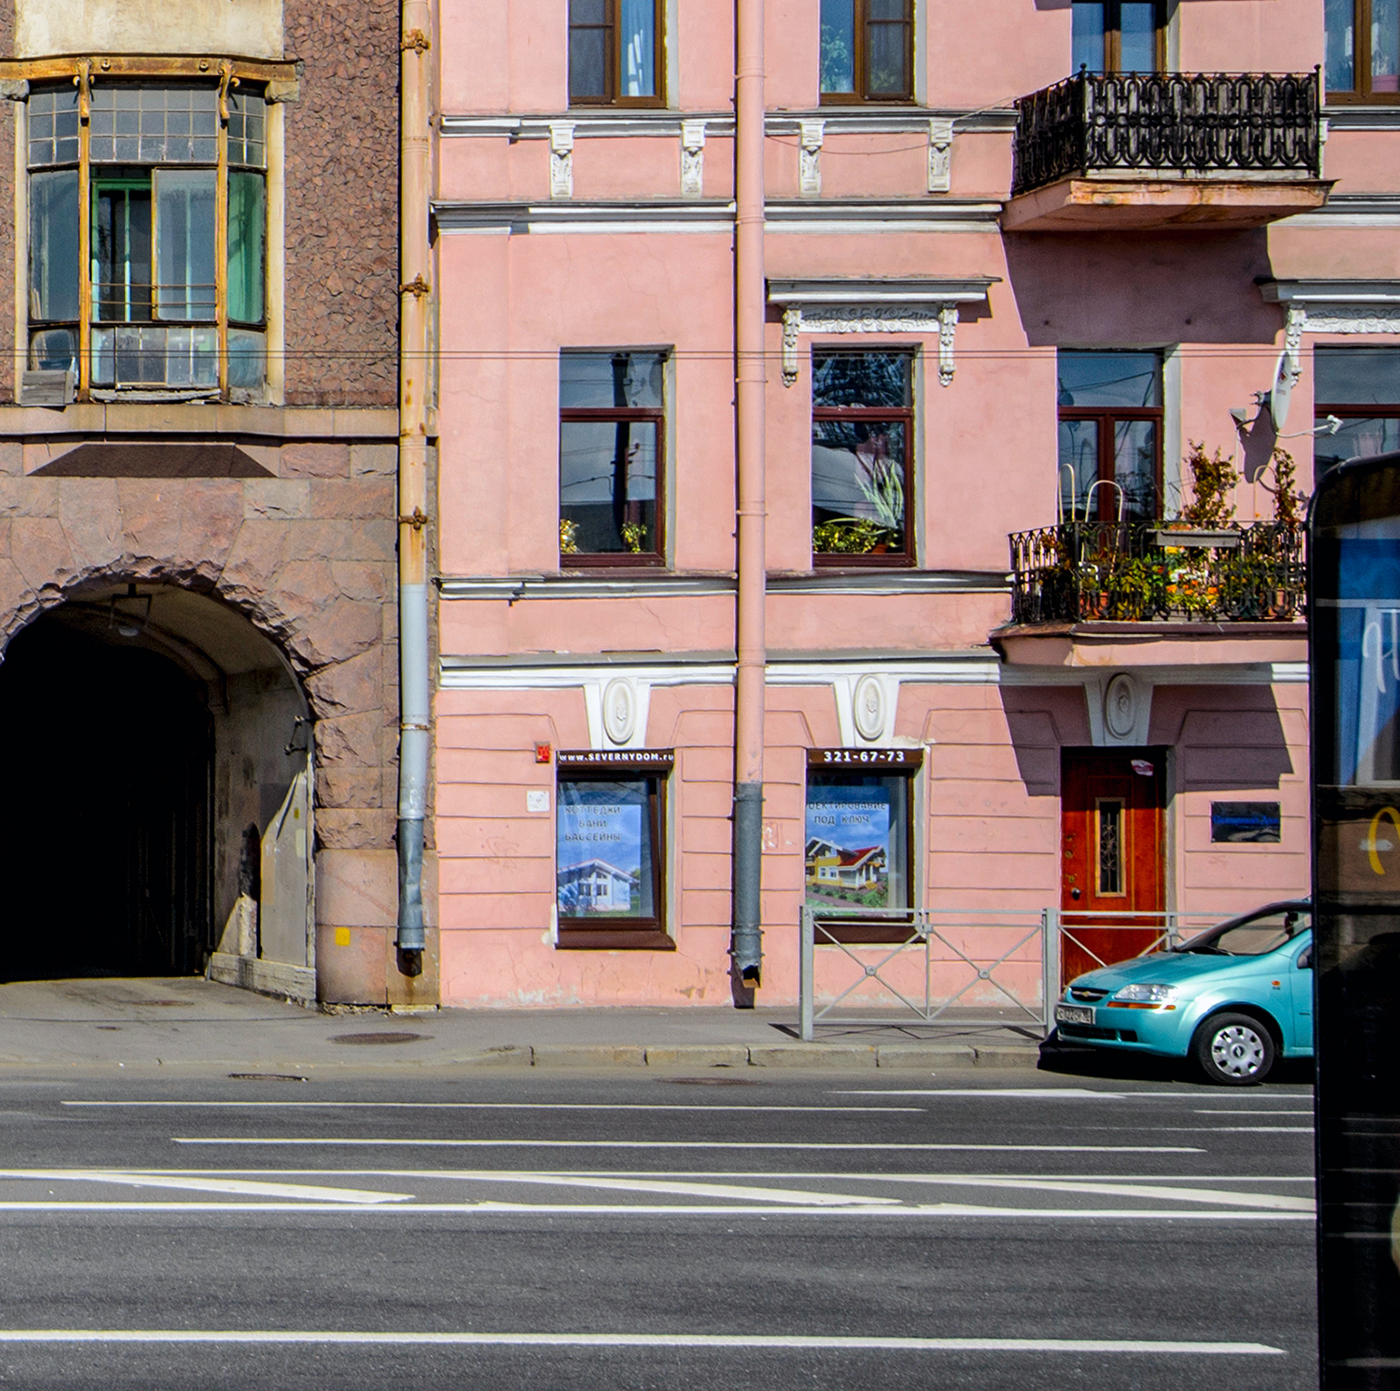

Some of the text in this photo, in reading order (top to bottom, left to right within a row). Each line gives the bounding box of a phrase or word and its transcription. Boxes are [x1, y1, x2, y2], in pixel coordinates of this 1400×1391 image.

[559, 752, 675, 762] www.SEVERNYDOM.ru
[823, 750, 905, 762] 321-67-73
[564, 805, 621, 816] КОТТЕДЖИ
[579, 819, 607, 828] БАНИ
[814, 815, 870, 826] ПОД КЛЮЧ
[564, 831, 621, 842] БАССЕЙНЫ
